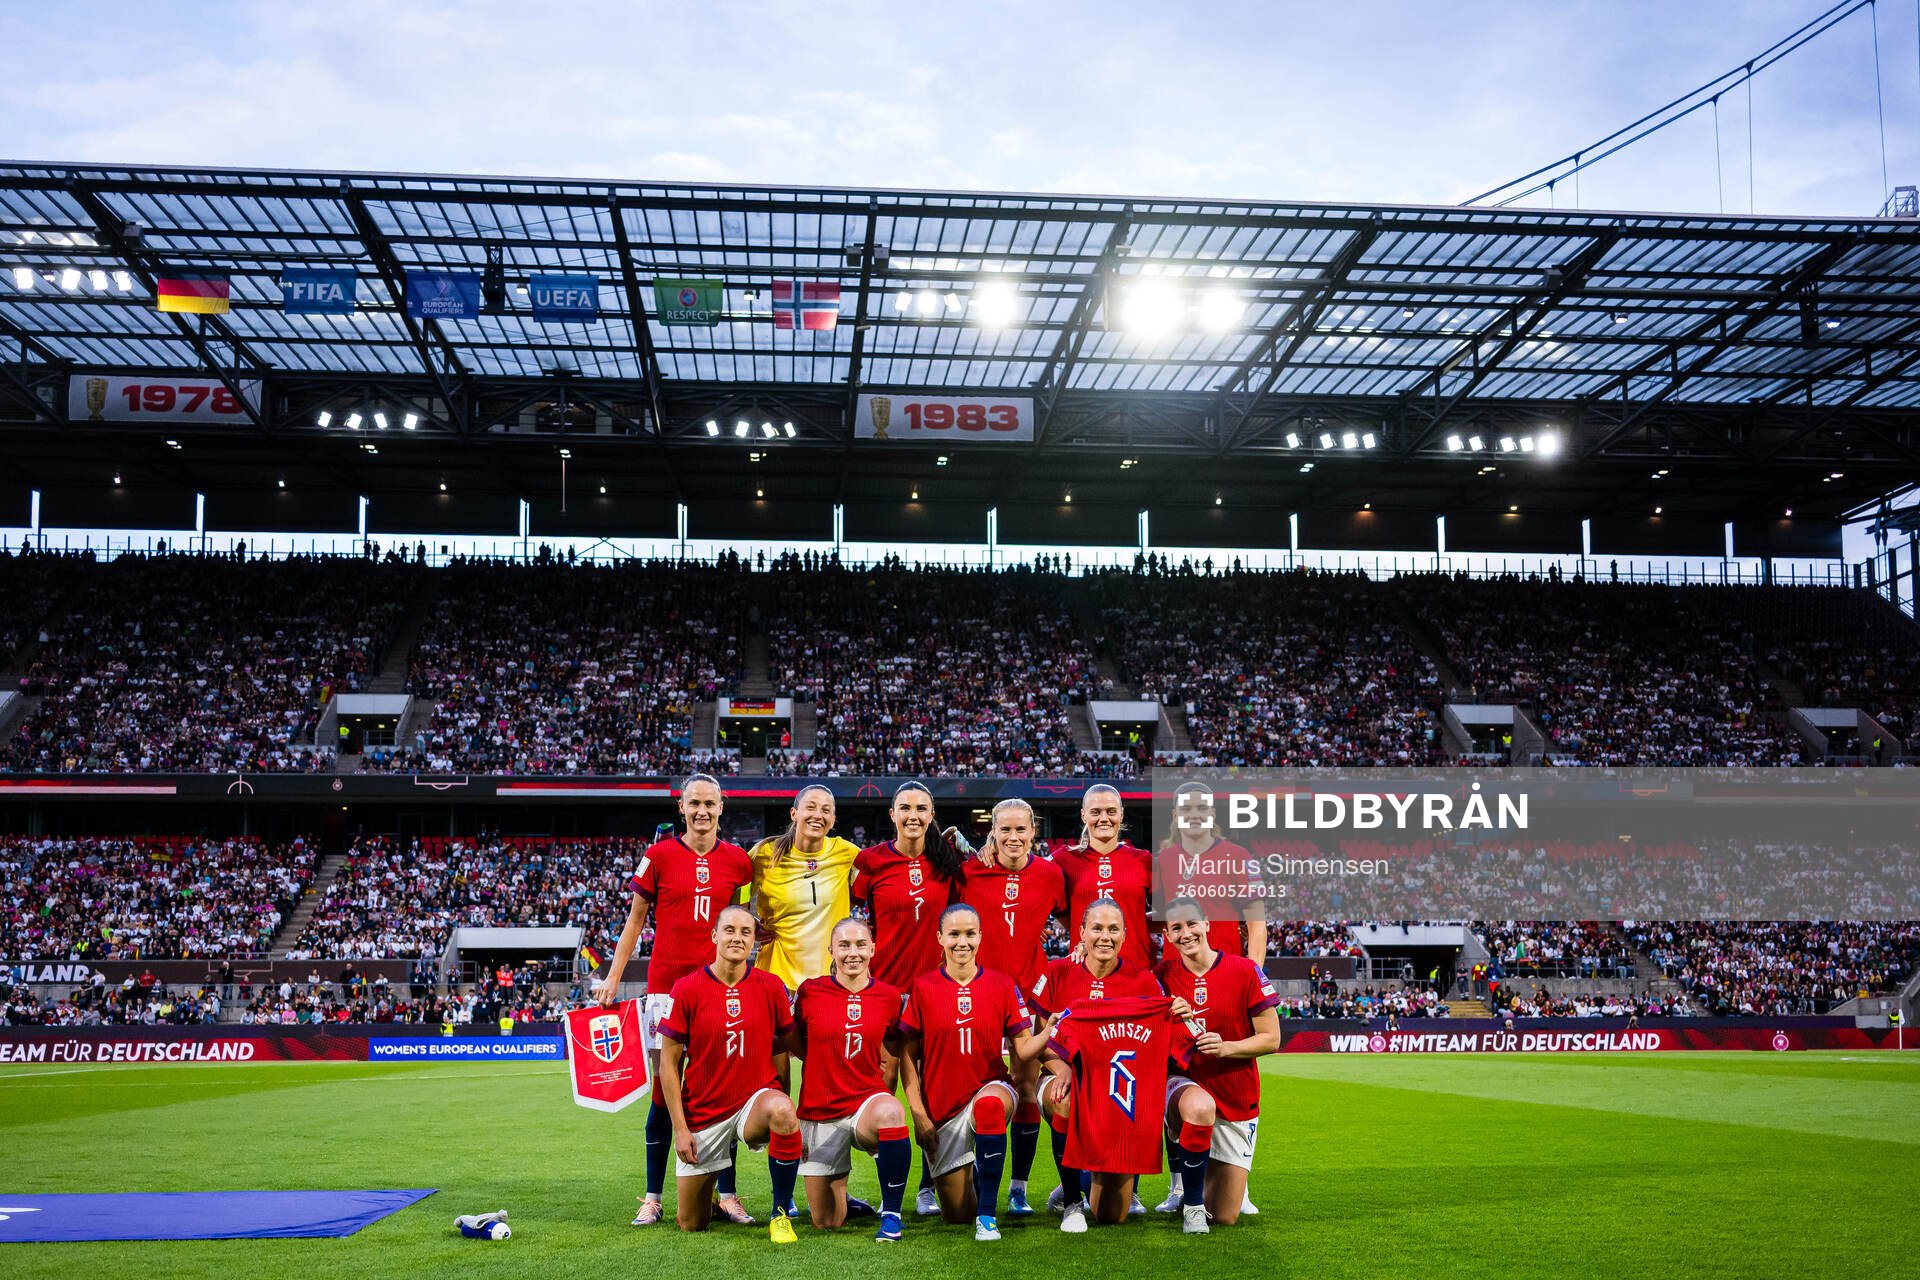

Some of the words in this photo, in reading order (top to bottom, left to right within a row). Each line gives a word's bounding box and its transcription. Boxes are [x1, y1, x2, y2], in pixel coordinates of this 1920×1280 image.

[293, 283, 344, 300] FIFA
[537, 290, 591, 307] UEFA
[667, 310, 710, 321] RESPECT
[122, 385, 244, 414] 1978
[904, 403, 1019, 431] 1983
[810, 881, 817, 906] 1
[694, 895, 711, 922] 10
[914, 897, 925, 922] 7
[1004, 912, 1015, 937] 4
[726, 1030, 744, 1059] 21
[958, 1027, 972, 1056] 11
[1098, 1022, 1152, 1043] HANSEN
[1330, 1034, 1368, 1052] WIR
[1388, 1034, 1477, 1052] #IMTEAM
[1482, 1031, 1517, 1051] FÜR
[1523, 1033, 1661, 1051] DEUTSCHLAND
[51, 1040, 93, 1062] FÜR
[96, 1042, 254, 1061] DEUTSCHLAND
[374, 1044, 427, 1055] WOMEN'S
[429, 1044, 486, 1055] EUROPEAN
[492, 1043, 557, 1055] QUALIFIERS
[845, 1032, 863, 1060] 13
[1109, 1050, 1136, 1123] 6
